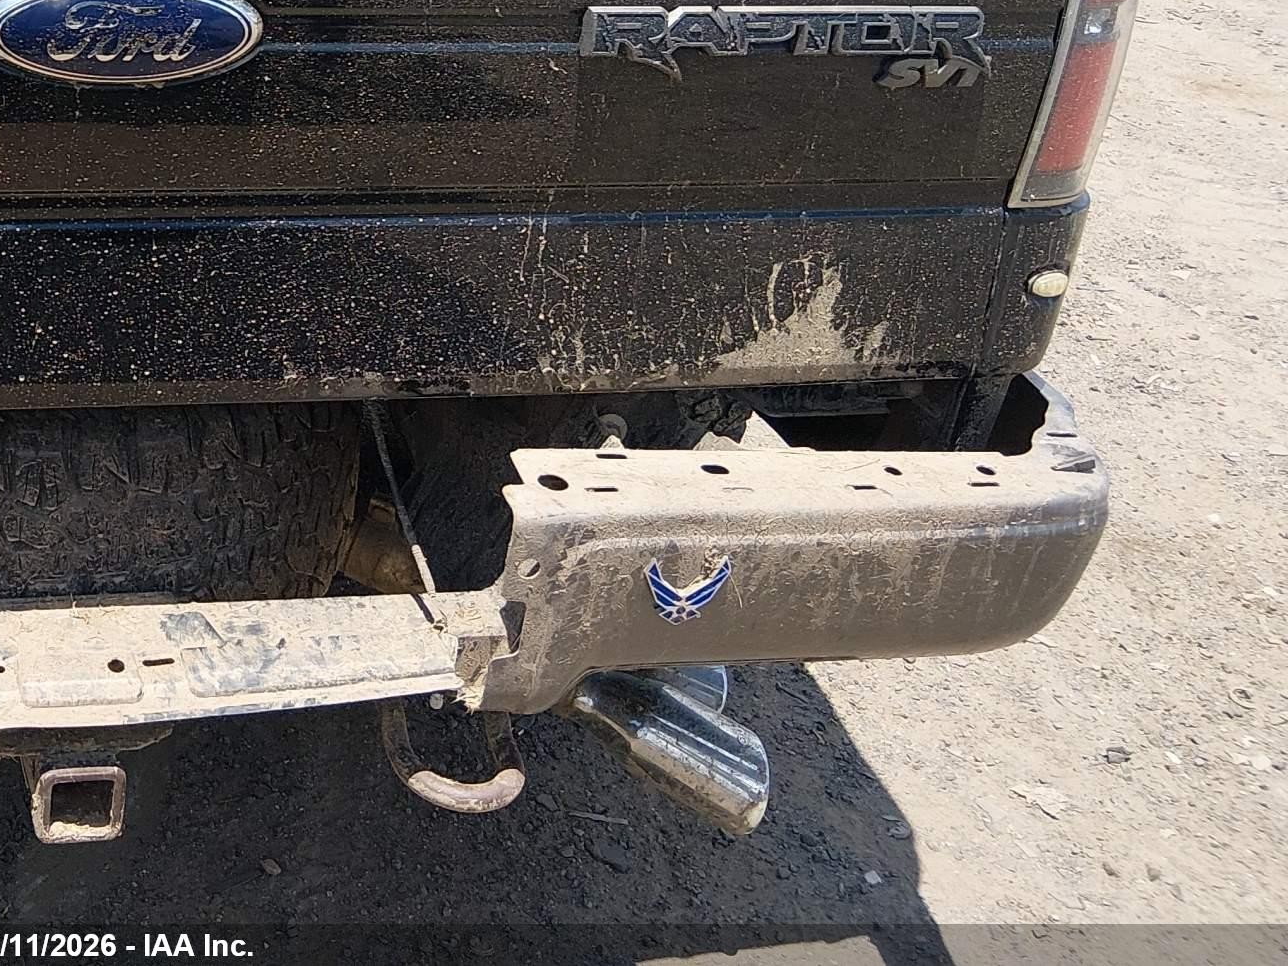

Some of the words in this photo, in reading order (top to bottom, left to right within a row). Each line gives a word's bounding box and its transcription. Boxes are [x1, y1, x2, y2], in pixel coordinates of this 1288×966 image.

[47, 0, 202, 62] Ford
[579, 5, 990, 78] RAPTOR
[875, 58, 982, 87] SVT
